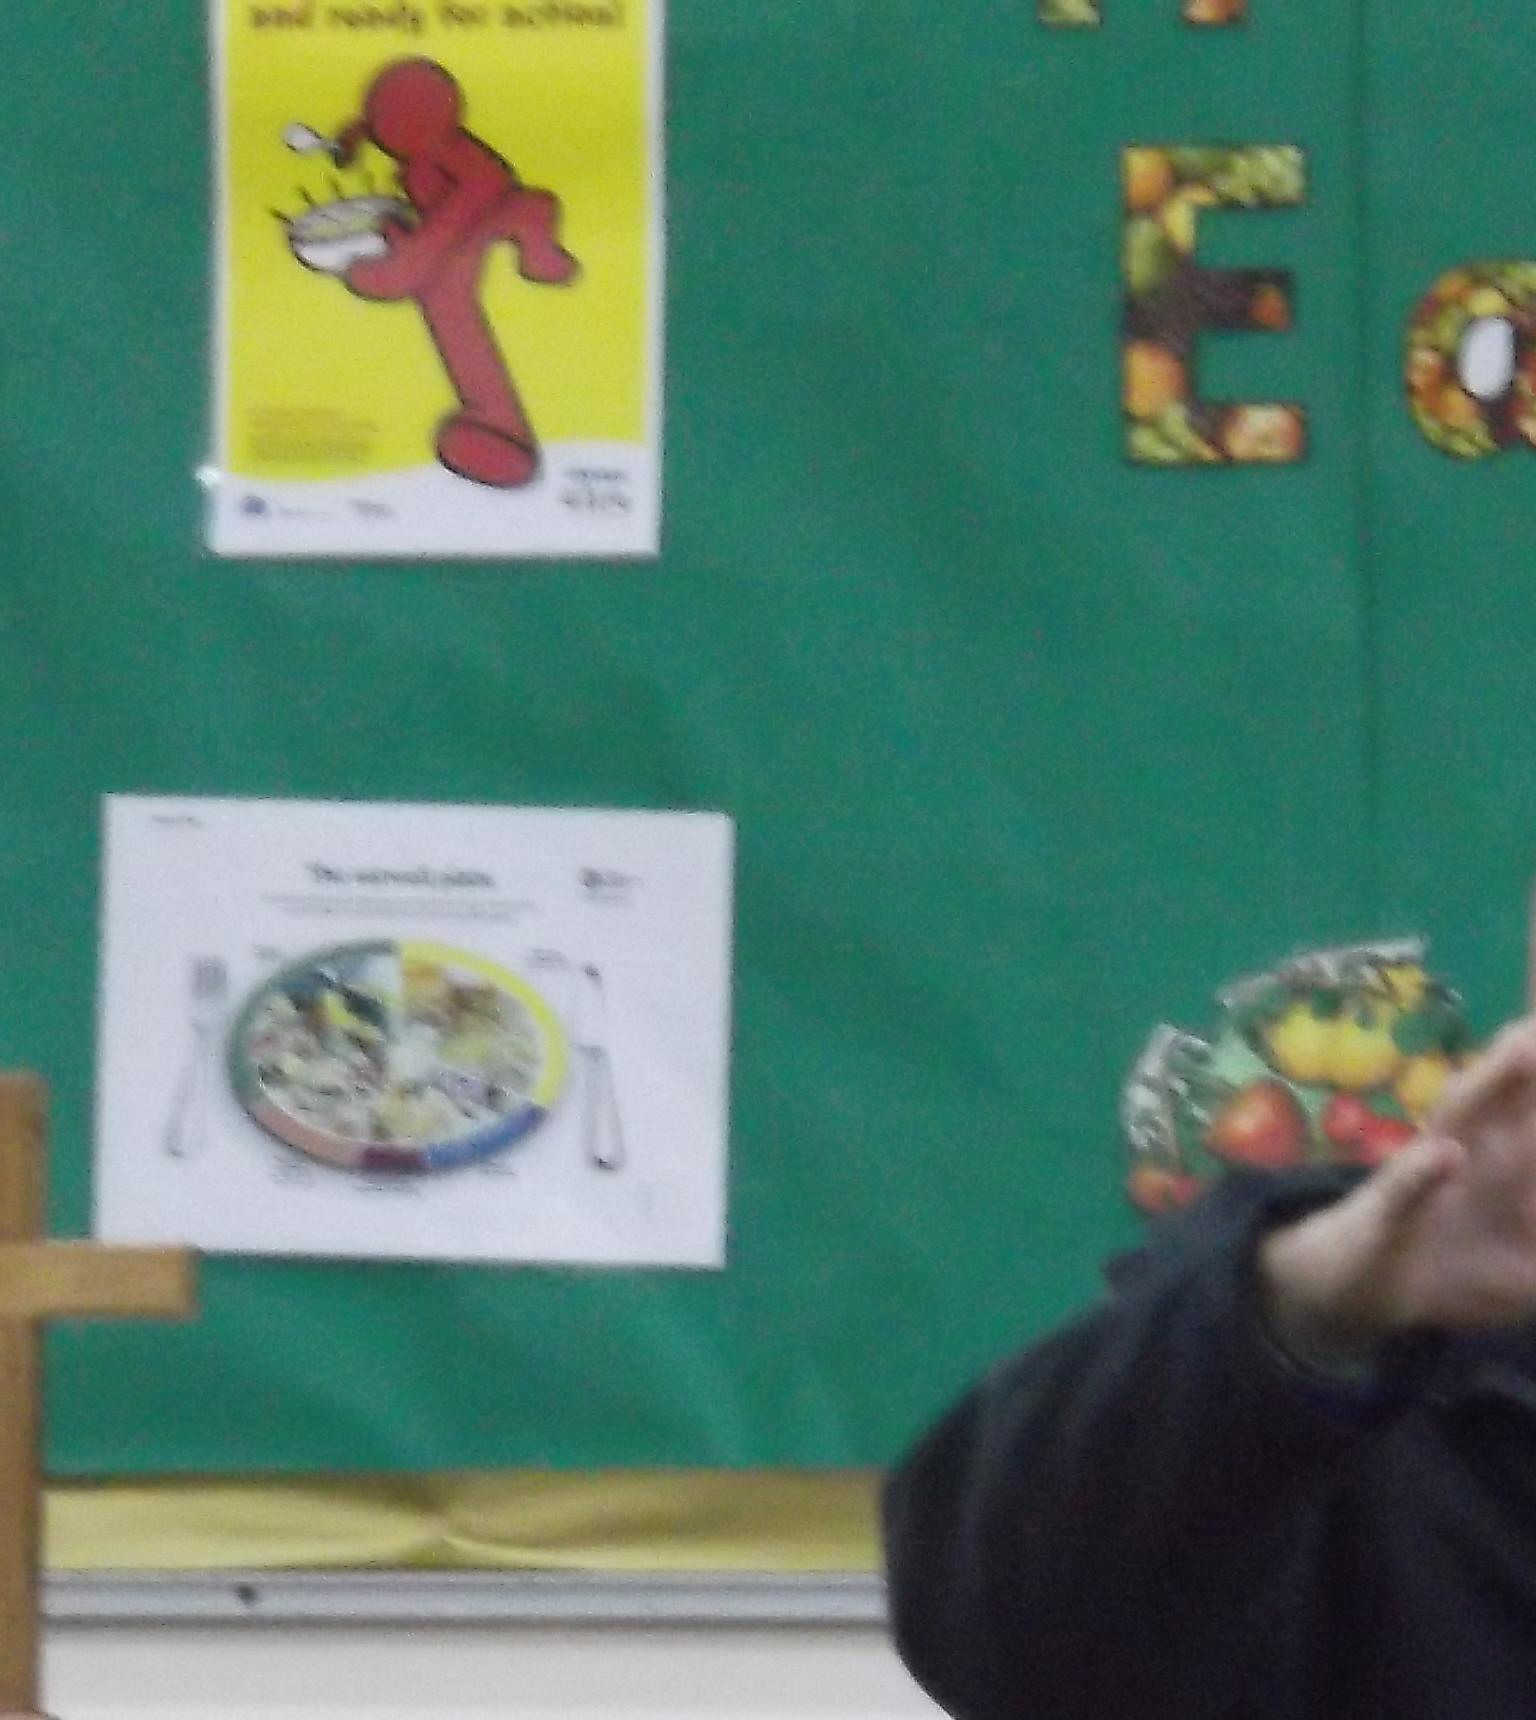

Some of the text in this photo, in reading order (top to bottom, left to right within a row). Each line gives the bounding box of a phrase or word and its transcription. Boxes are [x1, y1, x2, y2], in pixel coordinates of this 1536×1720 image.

[250, 0, 622, 35] and ready for action!
